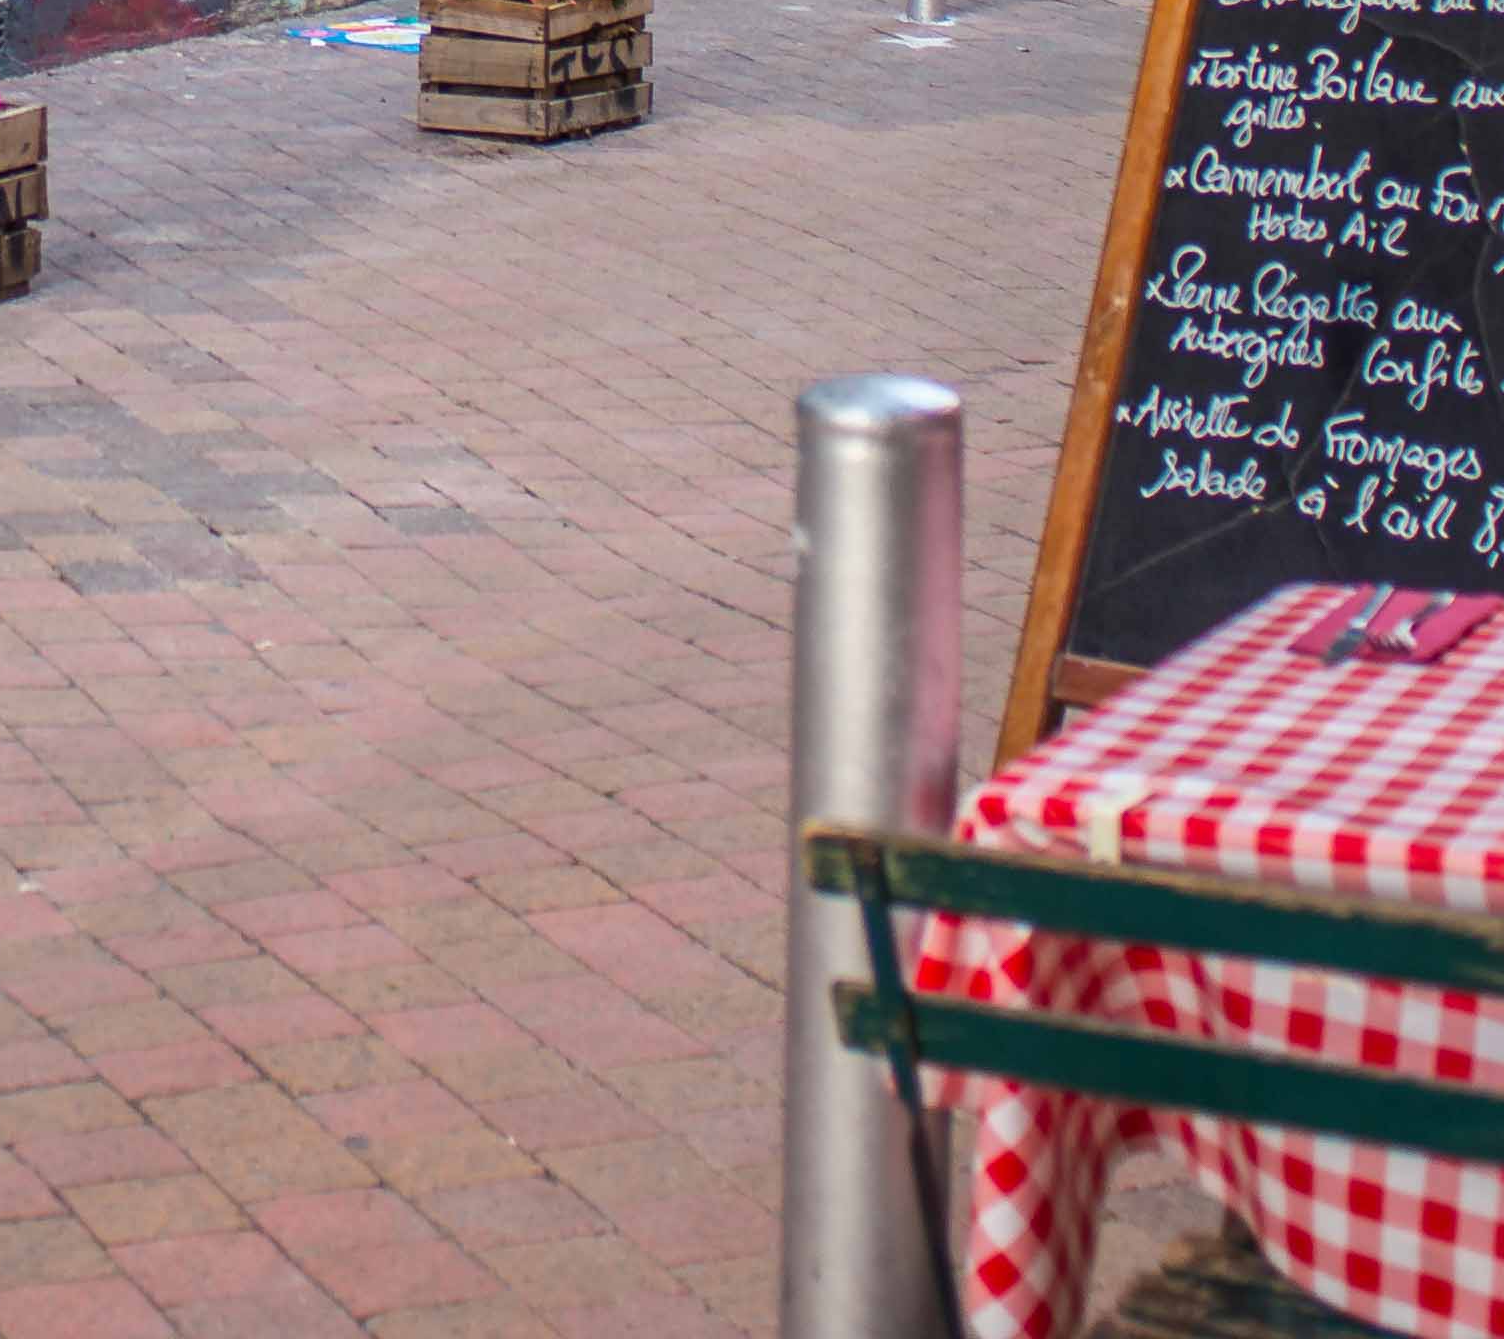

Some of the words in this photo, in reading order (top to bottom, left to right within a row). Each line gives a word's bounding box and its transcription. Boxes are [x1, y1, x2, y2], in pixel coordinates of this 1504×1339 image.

[1199, 43, 1300, 93] Tartine
[1190, 143, 1372, 205] Camembert
[1373, 177, 1423, 212] au
[1156, 244, 1243, 315] Penne
[1392, 298, 1463, 334] aux
[1168, 314, 1325, 390] Aubergines
[1133, 383, 1252, 439] Assiette
[1252, 399, 1300, 450] de
[1323, 411, 1484, 492] Fromages
[1139, 447, 1267, 500] Salade
[1297, 474, 1340, 521] à
